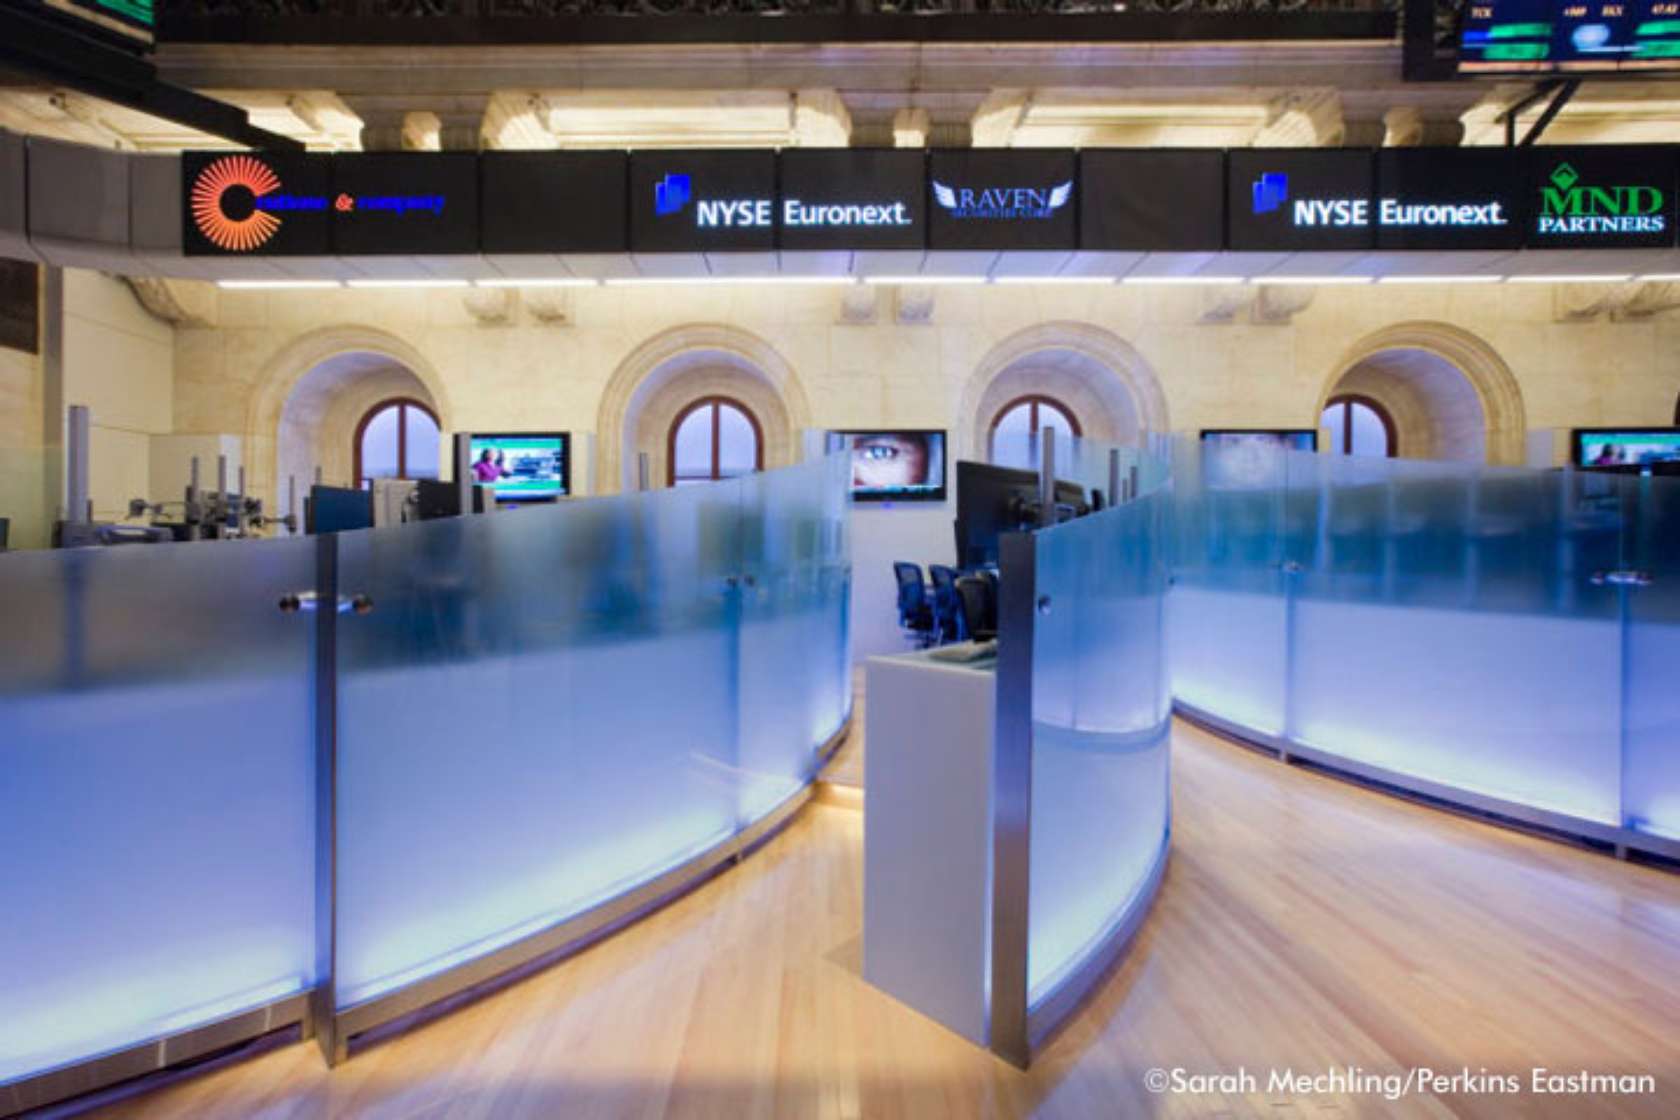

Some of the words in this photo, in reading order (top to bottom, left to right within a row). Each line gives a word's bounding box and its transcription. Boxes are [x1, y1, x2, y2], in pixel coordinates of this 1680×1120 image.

[959, 188, 1047, 208] RAVEN
[1541, 186, 1663, 216] MND
[698, 199, 771, 227] NYSE
[1295, 199, 1369, 226] NYSE
[1538, 216, 1665, 235] PARTNERS
